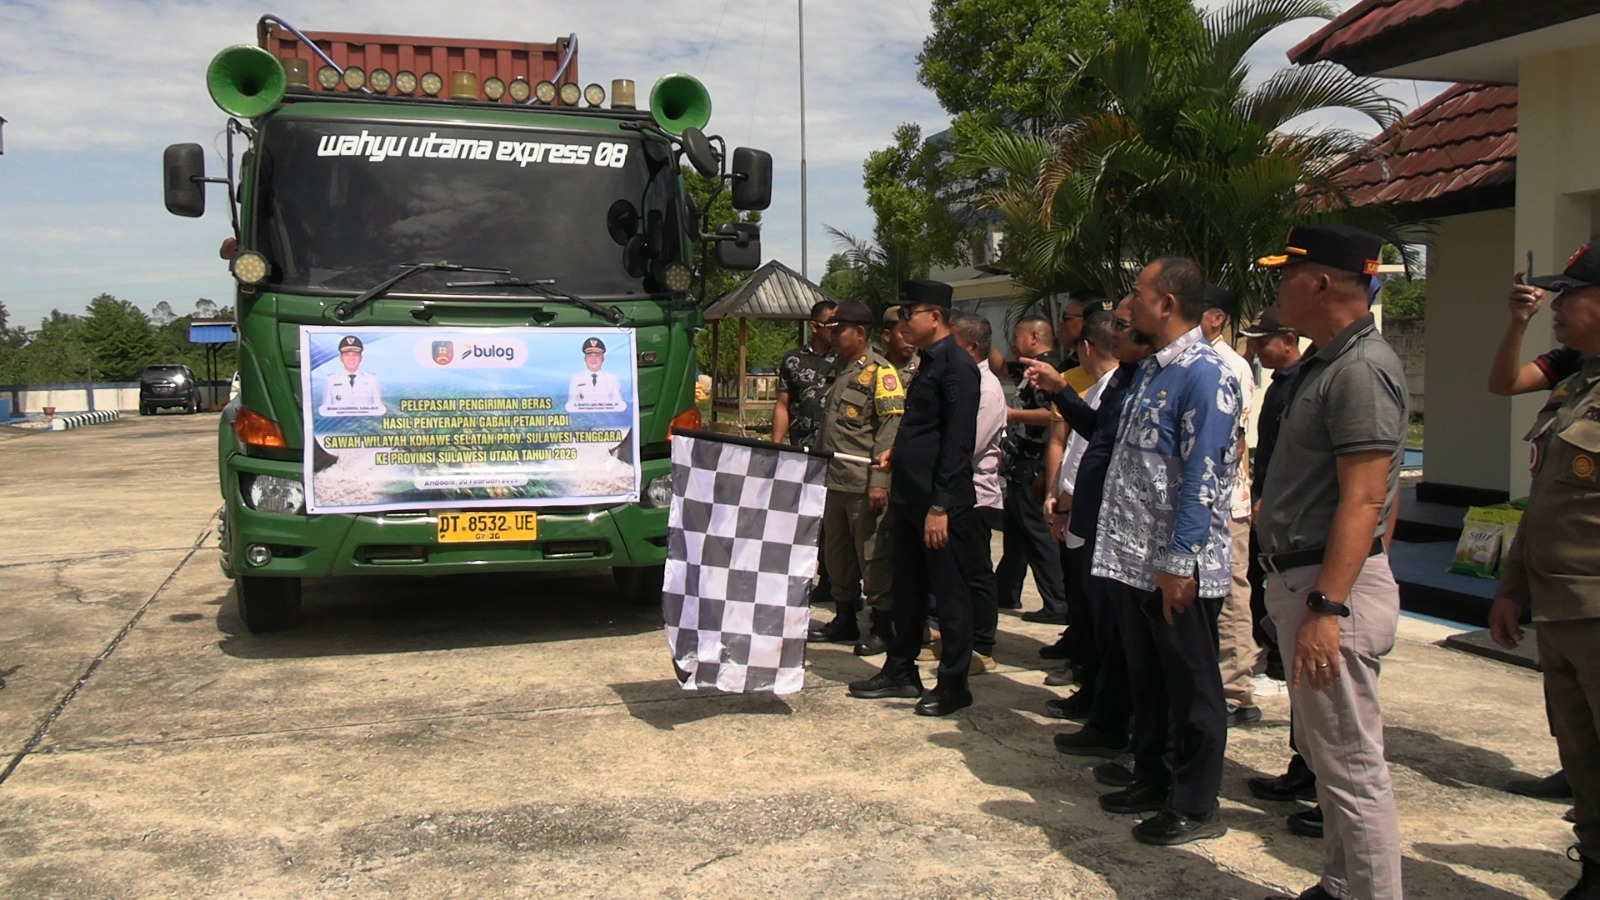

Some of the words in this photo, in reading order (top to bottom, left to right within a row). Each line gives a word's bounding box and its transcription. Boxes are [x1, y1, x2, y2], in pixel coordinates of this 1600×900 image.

[317, 130, 407, 162] wahyu
[408, 132, 493, 160] utama
[496, 140, 592, 167] express
[594, 142, 628, 168] 08
[474, 345, 514, 360] bulog
[401, 400, 456, 412] PELEPASAN
[458, 398, 518, 410] PENGIRIMAN
[522, 398, 552, 410] BERAS
[383, 418, 410, 430] HASIL
[414, 416, 476, 428] PENYERAPAN
[479, 416, 510, 428] GABAH
[513, 415, 545, 426] PETANI
[548, 414, 569, 426] PADI
[324, 436, 360, 448] SAWAH
[364, 435, 406, 448] WILAYAH
[409, 434, 450, 446] KONAWE
[454, 432, 494, 446] SELATAN
[496, 432, 524, 444] PROV.
[526, 431, 572, 444] SULAWESI
[575, 430, 622, 442] TENGGARA
[376, 452, 390, 464] KE
[390, 452, 436, 464] PROVINSI
[438, 450, 487, 463] SULAWESI
[490, 450, 519, 462] UTARA
[522, 449, 552, 460] TAHUN
[554, 448, 577, 460] 2026
[440, 516, 460, 532] DT
[468, 515, 508, 532] 8532
[515, 514, 534, 530] UE
